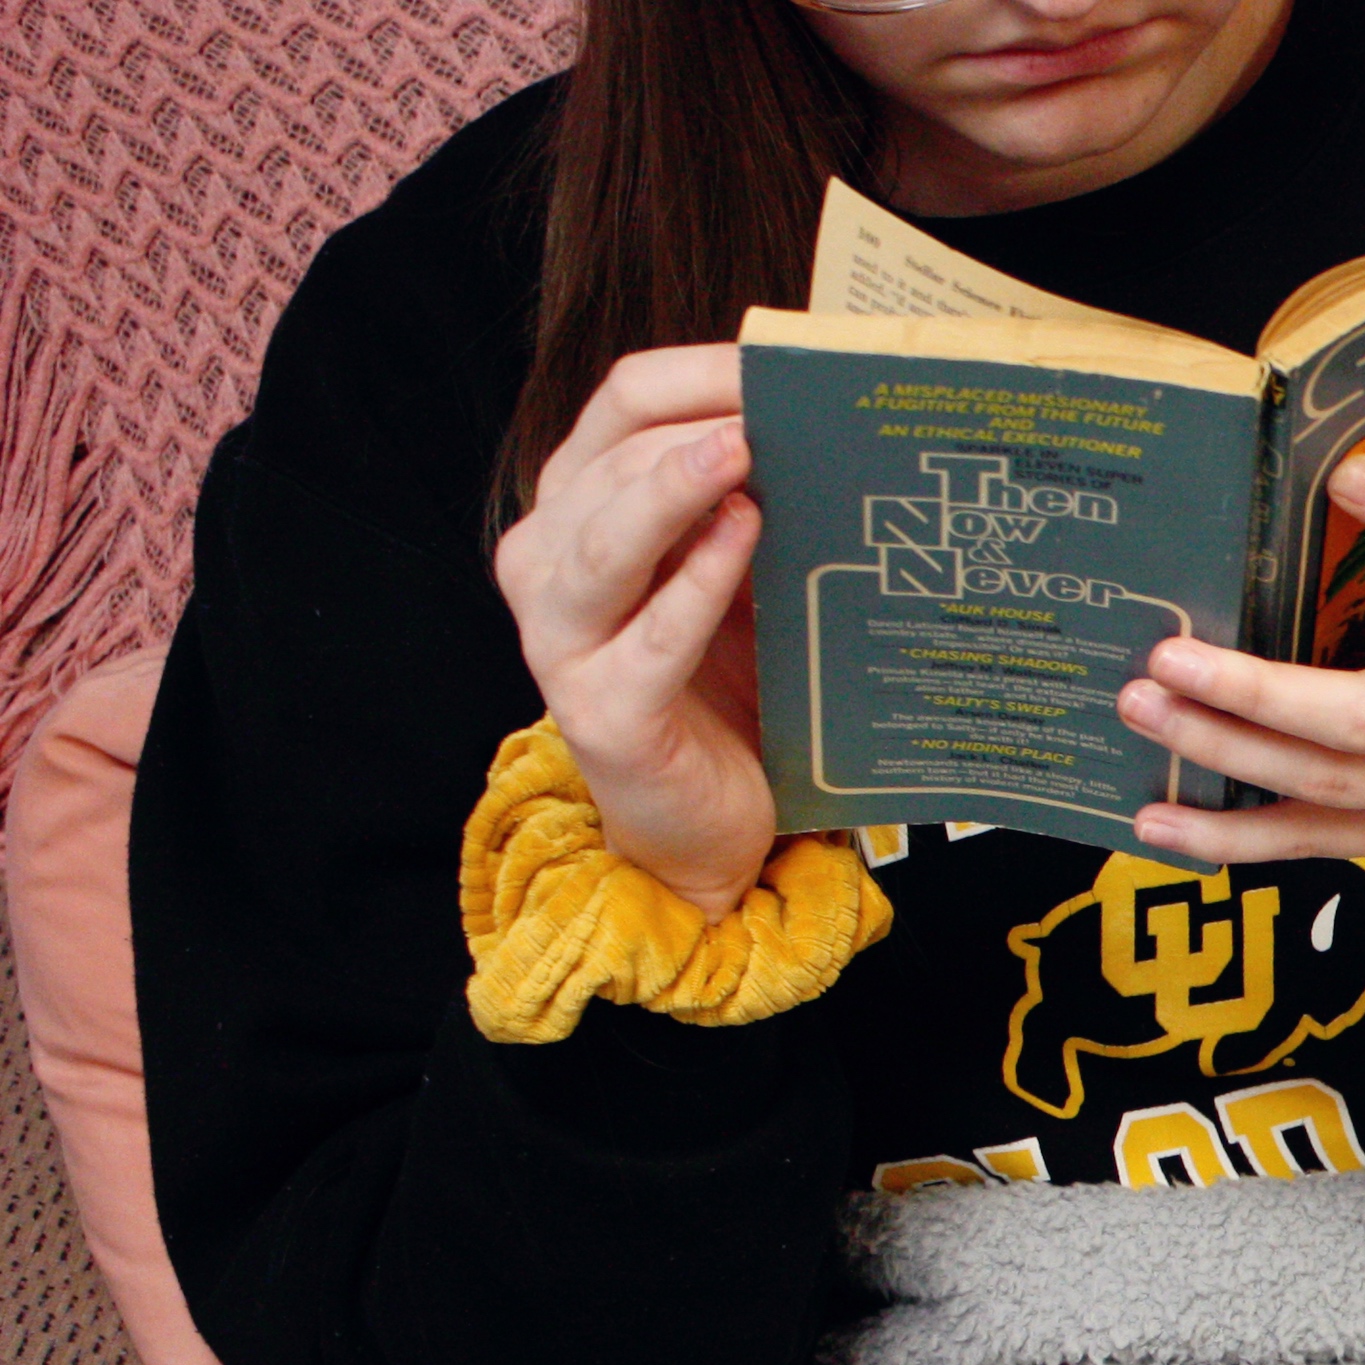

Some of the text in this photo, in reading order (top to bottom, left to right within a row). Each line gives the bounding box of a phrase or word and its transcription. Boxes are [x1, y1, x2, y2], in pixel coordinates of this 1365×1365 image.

[856, 396, 1165, 435] A FUGITIVE FROM THE FUTURE
[874, 383, 1148, 417] A MISPLACED MISSIONARY
[989, 417, 1035, 430] AND
[878, 424, 1143, 459] AN ETHICAL EXECUTIONER
[919, 451, 1118, 525] Then
[863, 495, 1047, 549] Now
[966, 537, 1013, 565] &
[878, 546, 1127, 608] Never
[990, 607, 1056, 623] HOUSE
[910, 649, 1089, 677] CHASING SHADOWS
[1005, 701, 1067, 717] SWEEP
[921, 739, 1076, 766] NO HIDING PLACE
